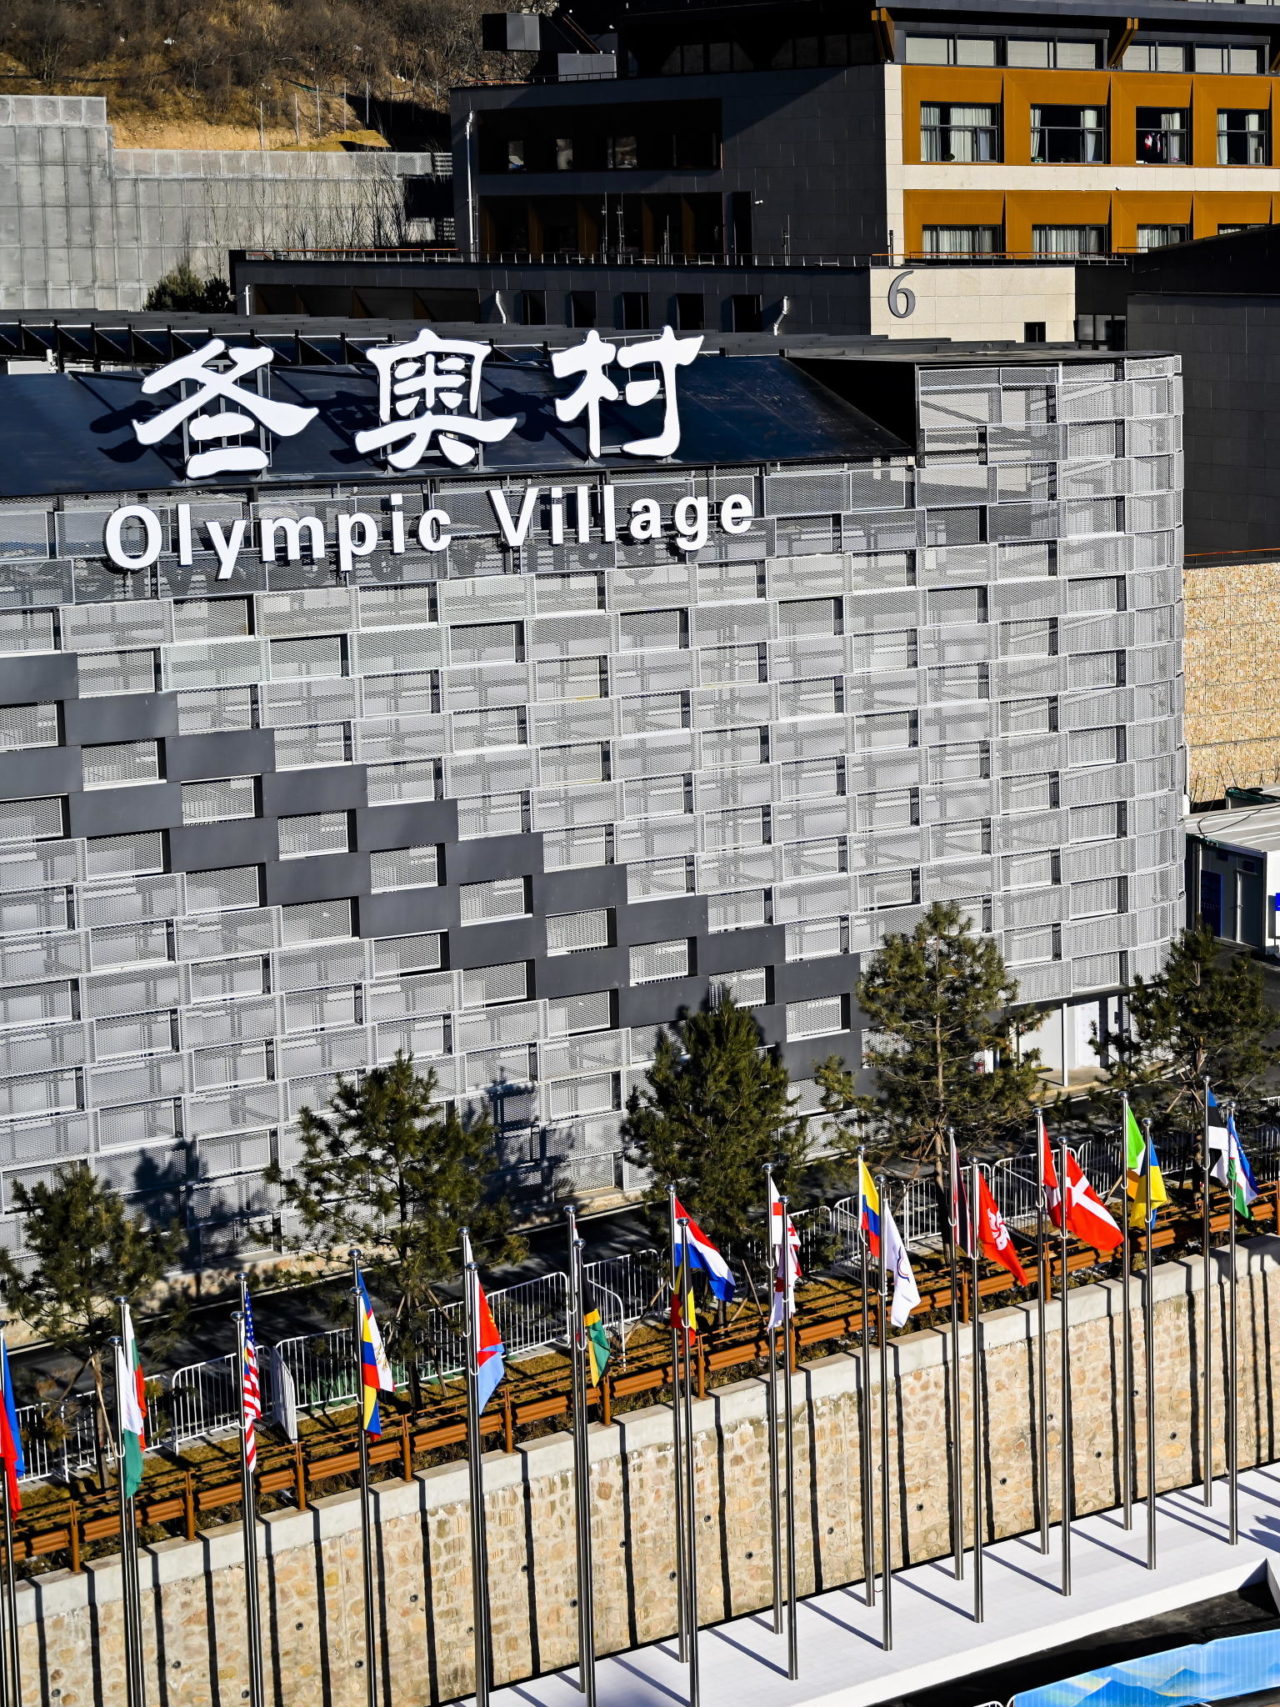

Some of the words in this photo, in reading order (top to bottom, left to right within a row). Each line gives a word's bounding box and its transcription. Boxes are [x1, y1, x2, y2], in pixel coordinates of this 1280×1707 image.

[887, 269, 917, 319] 6
[131, 324, 704, 479] 冬奥村
[103, 493, 452, 580] Olympic
[488, 485, 755, 551] Village
